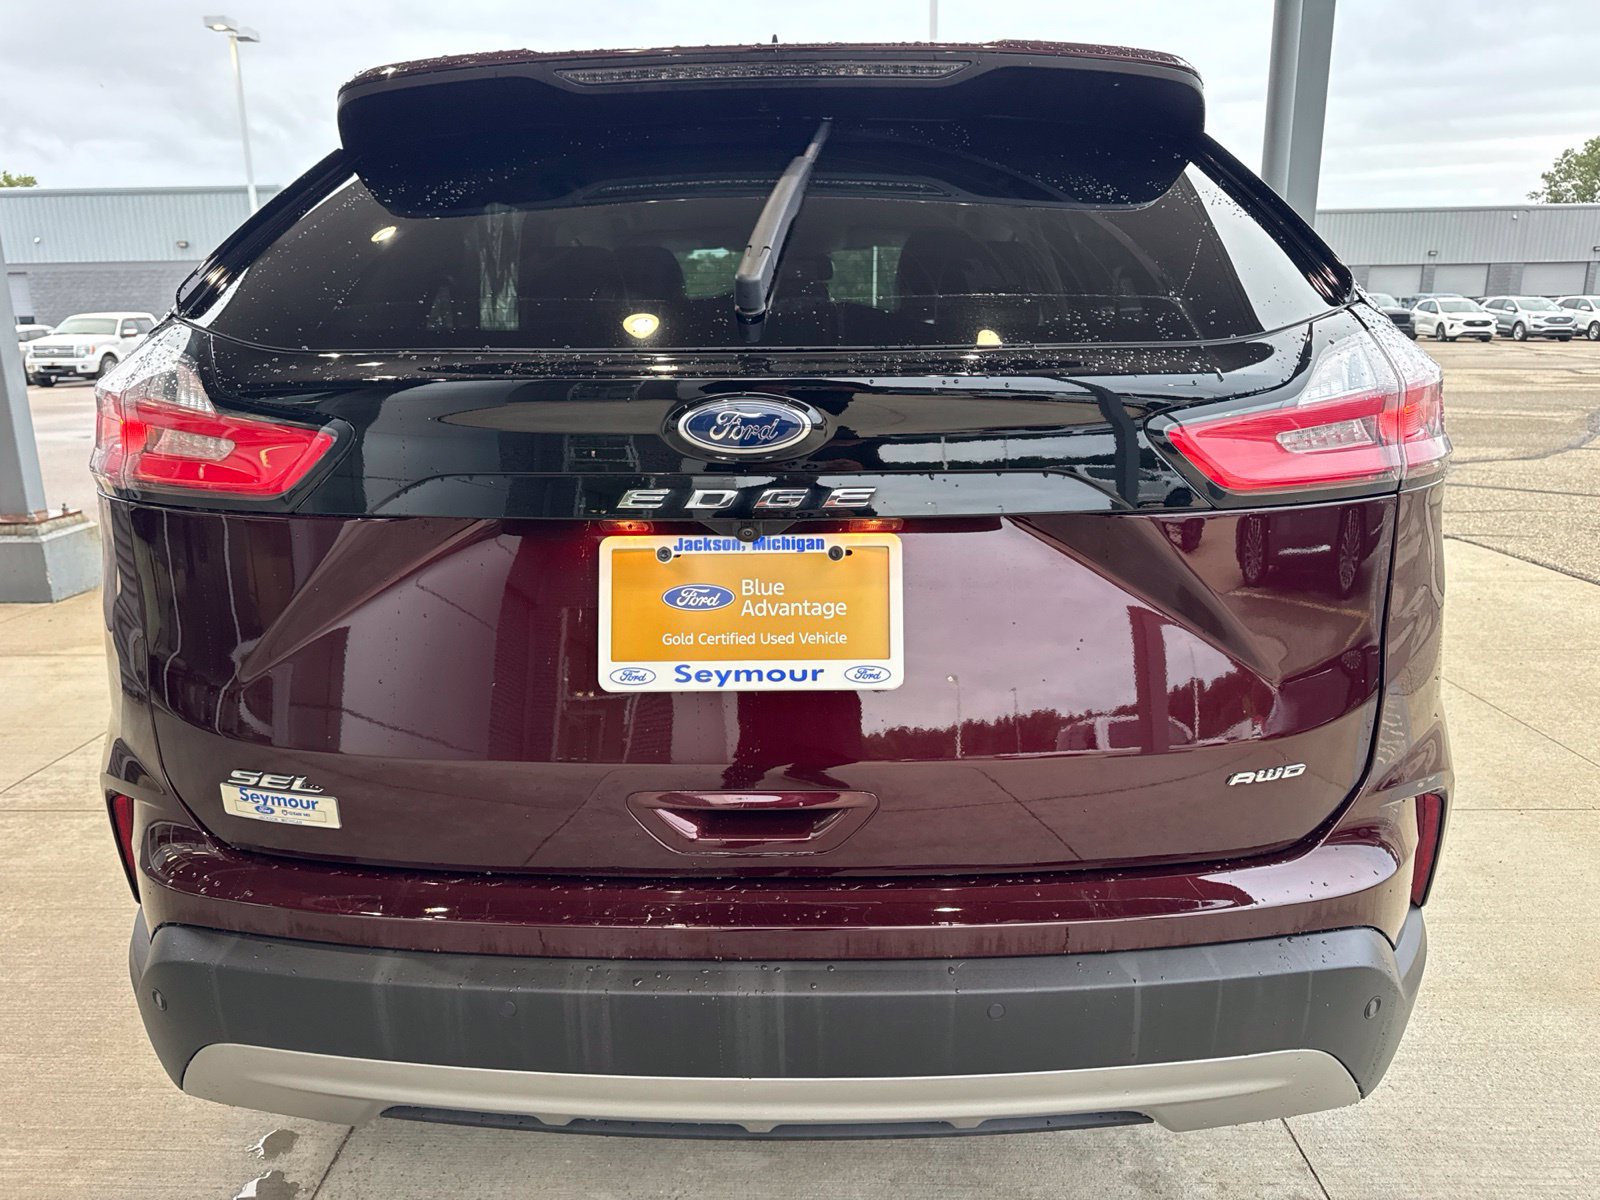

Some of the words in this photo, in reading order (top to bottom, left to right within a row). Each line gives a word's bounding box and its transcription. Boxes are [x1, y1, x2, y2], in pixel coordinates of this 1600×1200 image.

[709, 410, 780, 441] Ford
[617, 486, 877, 509] EDGE
[673, 537, 746, 552] Jackson,
[752, 535, 825, 553] Michigan
[676, 587, 721, 607] Ford
[741, 578, 785, 596] Blue
[741, 599, 848, 619] Advantage
[662, 633, 694, 645] Gold
[698, 632, 756, 645] Certified
[760, 632, 795, 645] Used
[799, 632, 848, 644] Vehicle
[619, 670, 647, 682] Ford
[674, 664, 825, 687] Seymour
[854, 668, 882, 680] Ford
[227, 769, 324, 793] SEL
[1228, 763, 1307, 786] AWD
[239, 786, 319, 811] Seymour
